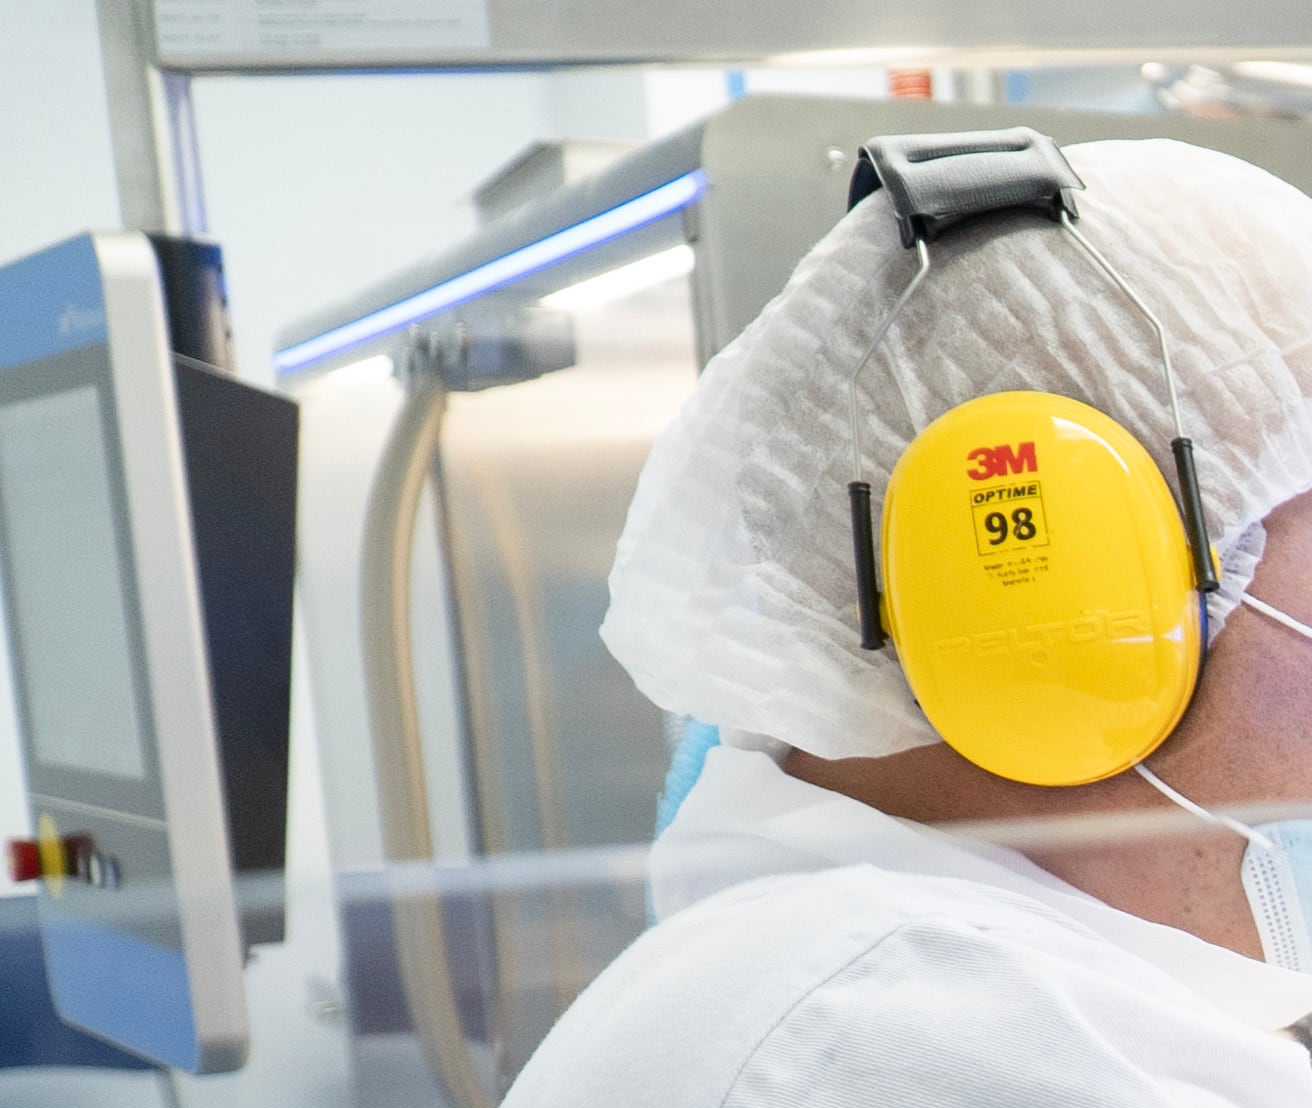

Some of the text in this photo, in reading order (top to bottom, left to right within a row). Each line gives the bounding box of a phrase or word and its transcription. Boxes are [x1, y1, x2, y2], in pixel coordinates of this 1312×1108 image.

[966, 441, 1038, 481] 3M
[973, 484, 1037, 504] OPTIME
[985, 507, 1037, 545] 98
[931, 608, 1151, 662] PELTOR
